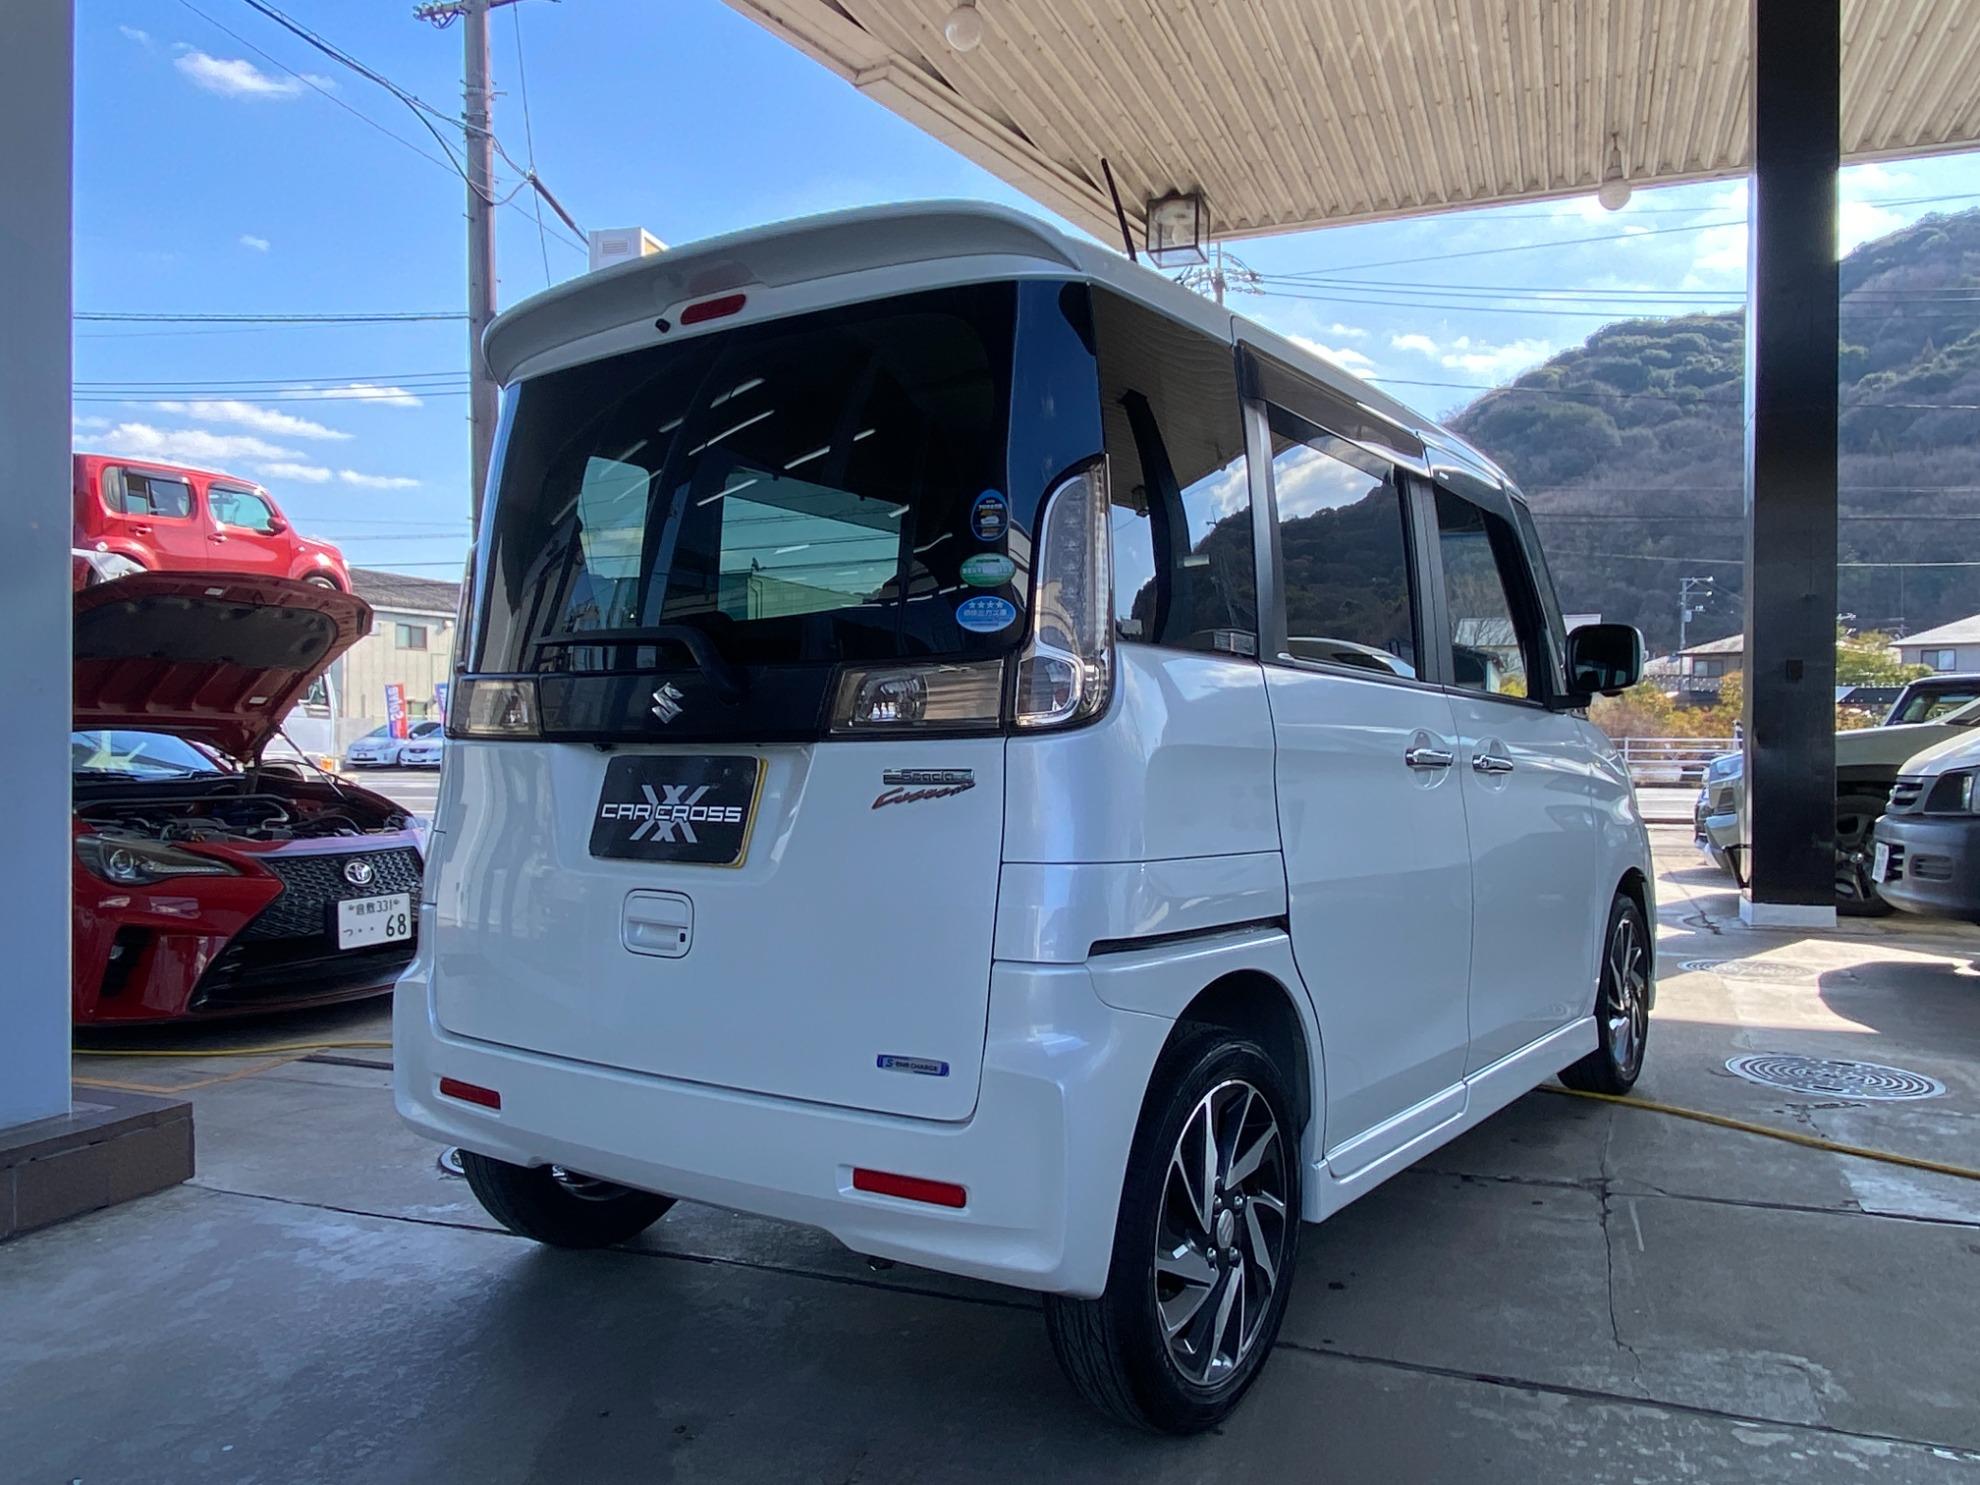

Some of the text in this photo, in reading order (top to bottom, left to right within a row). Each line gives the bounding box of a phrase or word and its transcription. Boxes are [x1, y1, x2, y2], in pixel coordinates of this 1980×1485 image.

[601, 803, 743, 823] CAR CROSS
[376, 899, 393, 913] 331
[386, 913, 406, 937] 68
